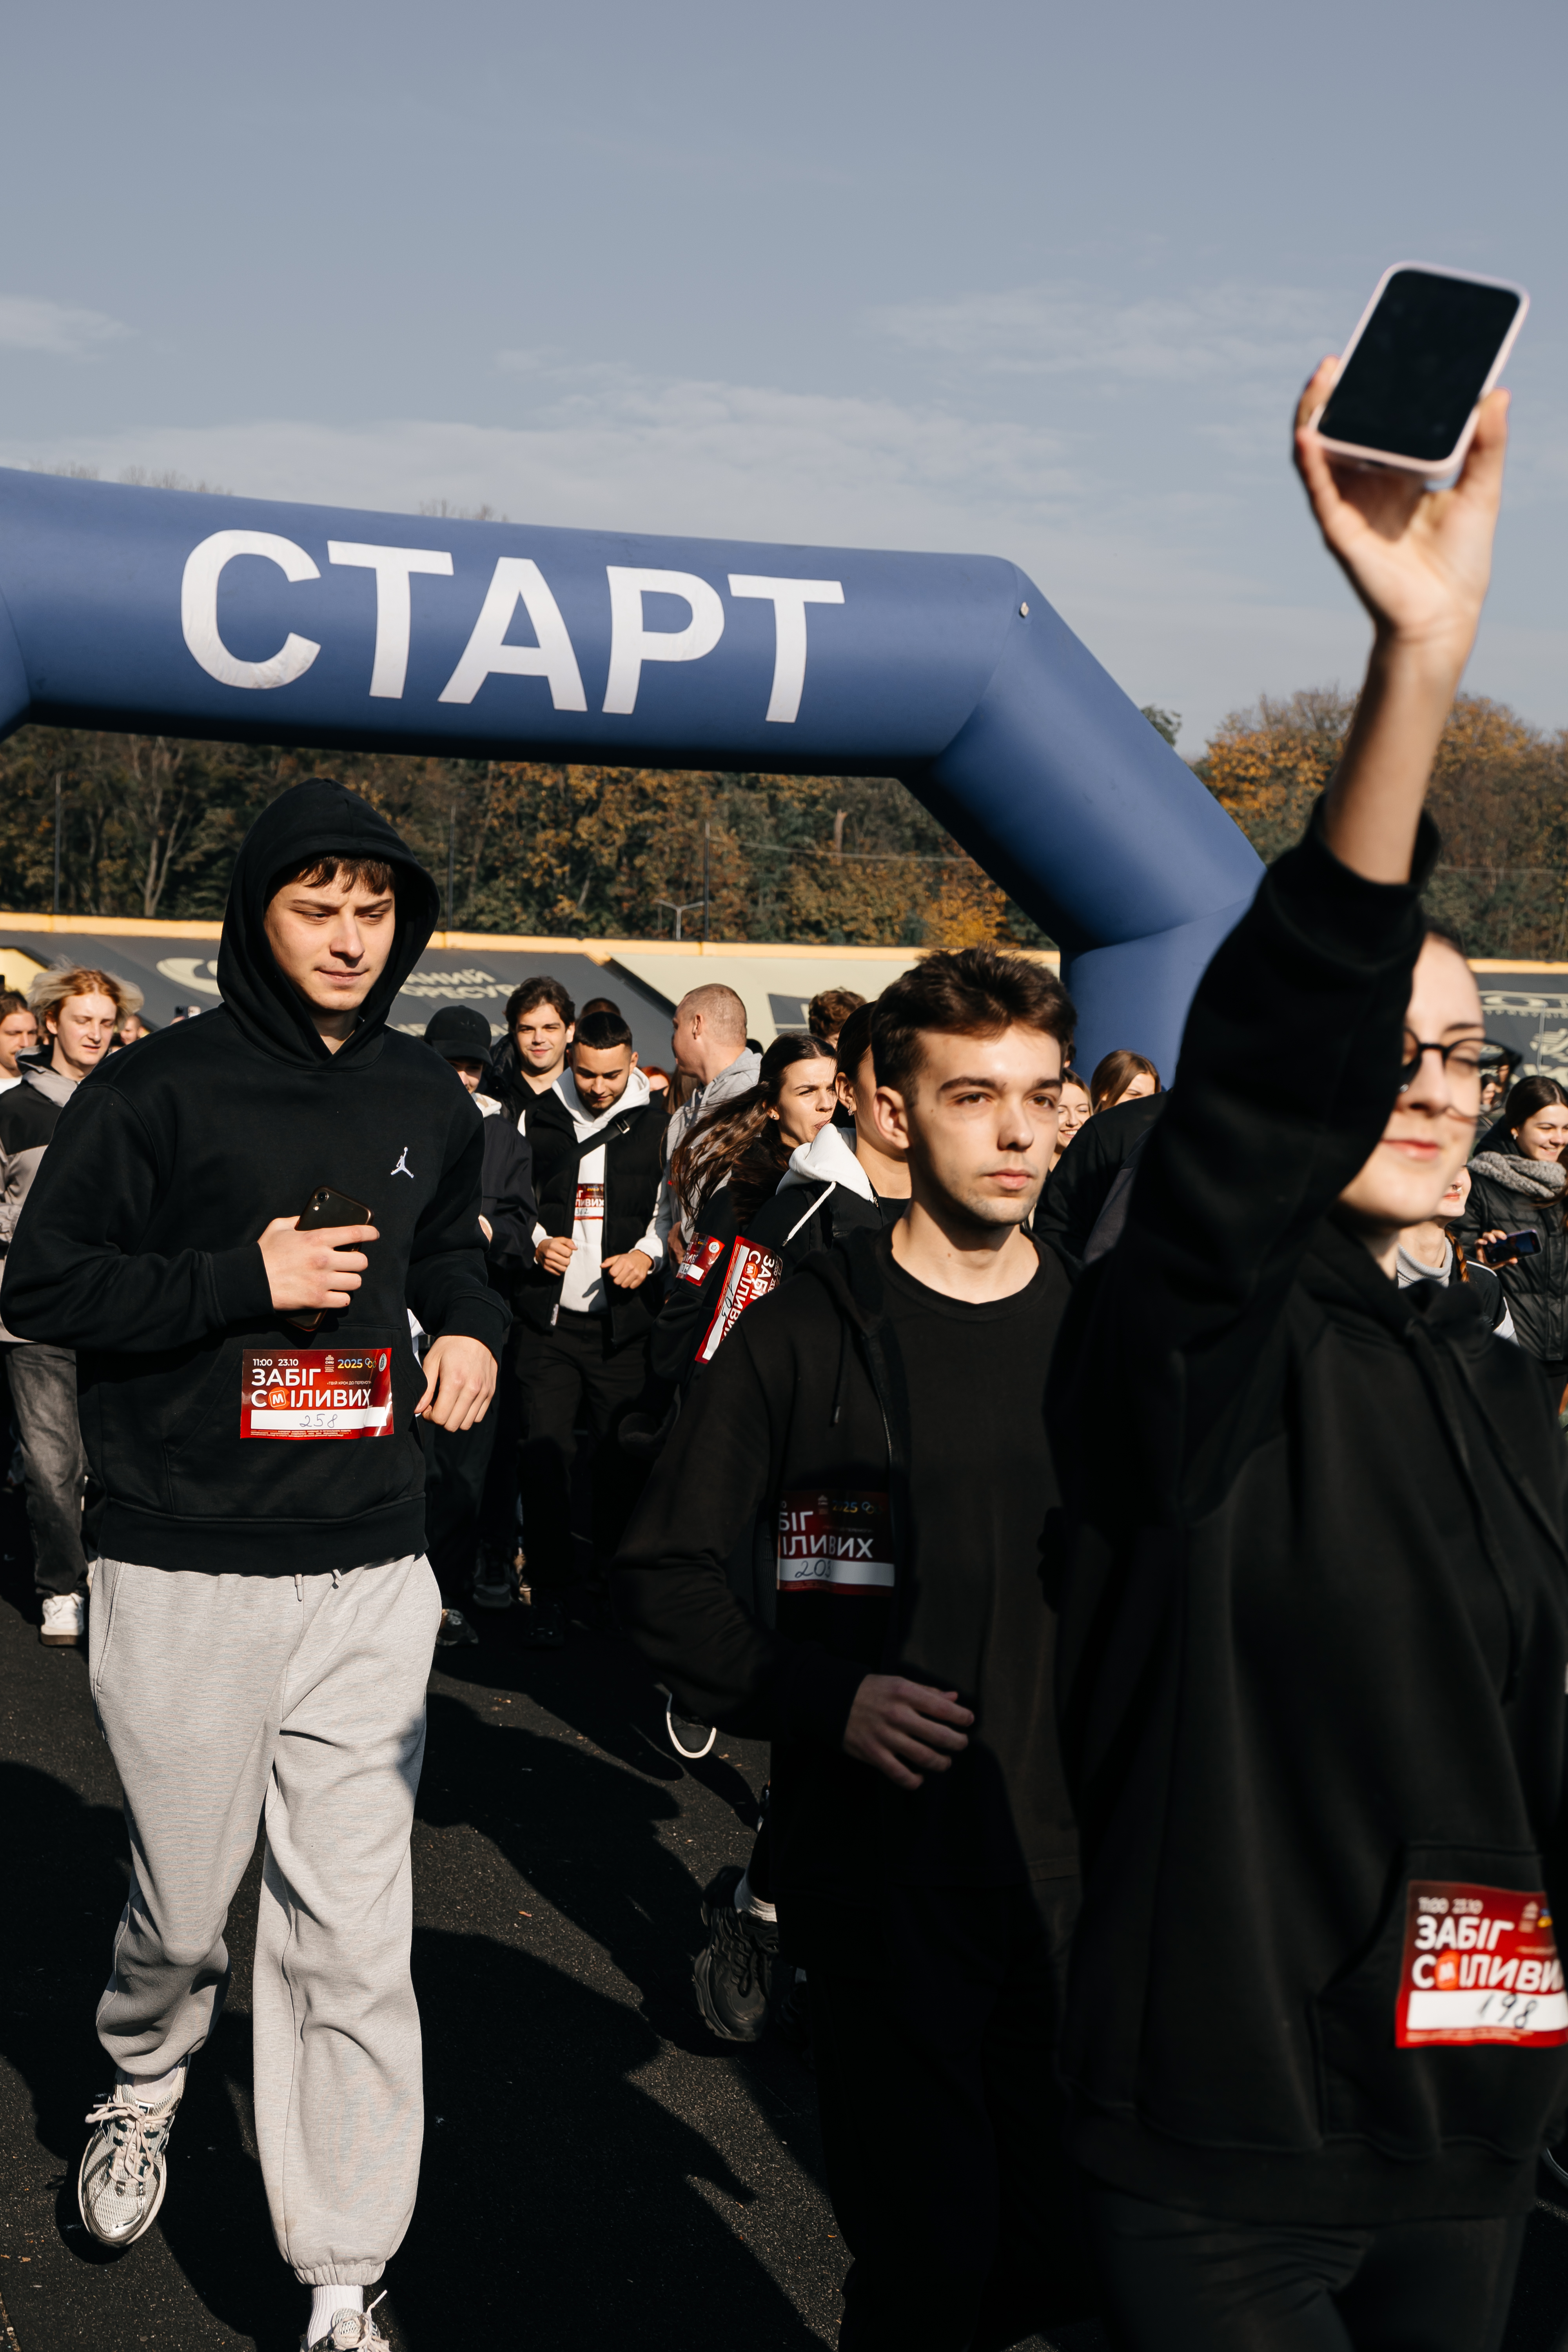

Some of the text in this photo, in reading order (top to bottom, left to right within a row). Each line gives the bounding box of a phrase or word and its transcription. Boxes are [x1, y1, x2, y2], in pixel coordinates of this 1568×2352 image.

[181, 529, 845, 723] СТАРТ
[722, 1250, 761, 1341] СМІЛИВИ
[251, 1368, 321, 1387] ЗАБІГ
[338, 1359, 363, 1369] 2025
[299, 1414, 338, 1428] 258
[1414, 1915, 1515, 1951] ЗАБІГ
[1477, 1994, 1538, 2029] 198
